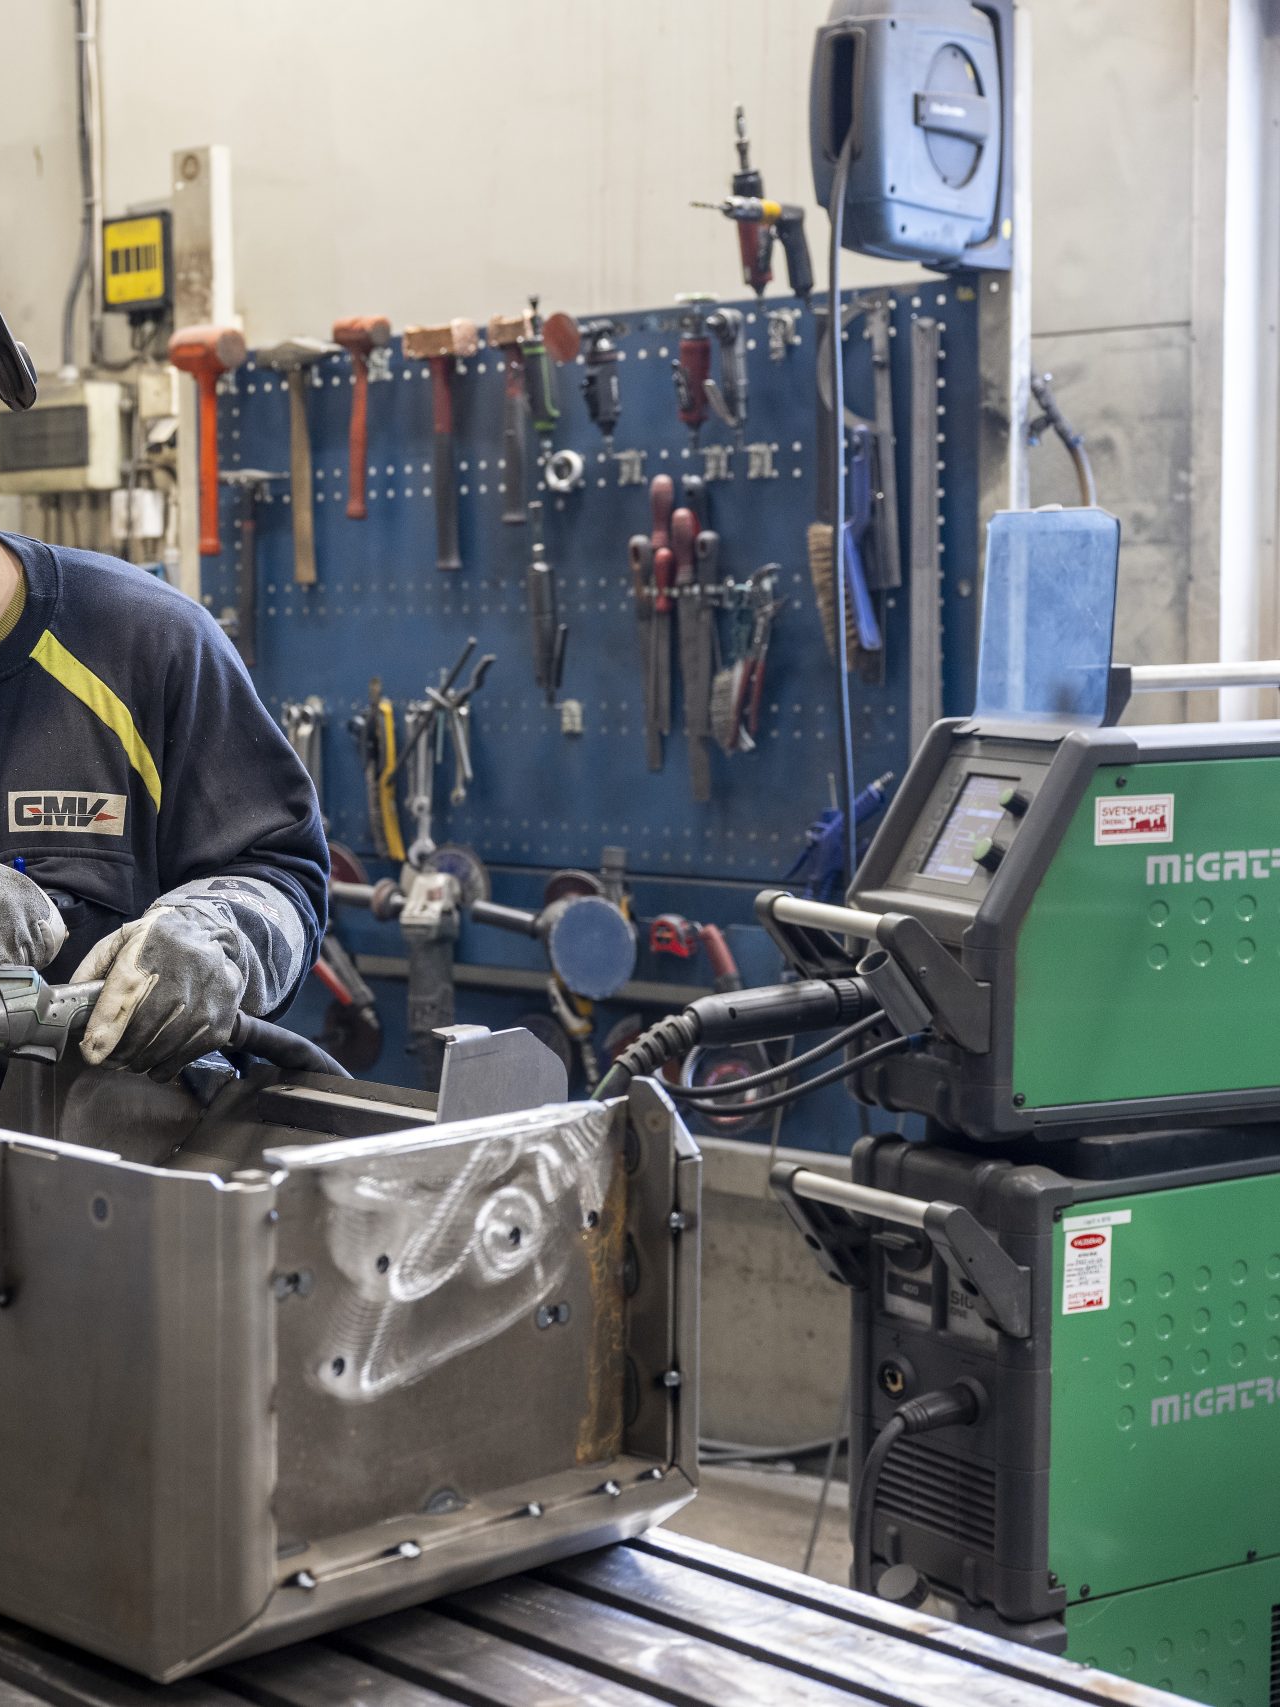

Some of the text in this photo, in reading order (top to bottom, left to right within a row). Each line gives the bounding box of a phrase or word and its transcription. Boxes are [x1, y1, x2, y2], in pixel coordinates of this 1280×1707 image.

[14, 796, 108, 827] GMV
[1102, 804, 1168, 816] SVETSHUSET
[1146, 848, 1280, 885] MIGAT
[1151, 1377, 1280, 1427] MIGATR
